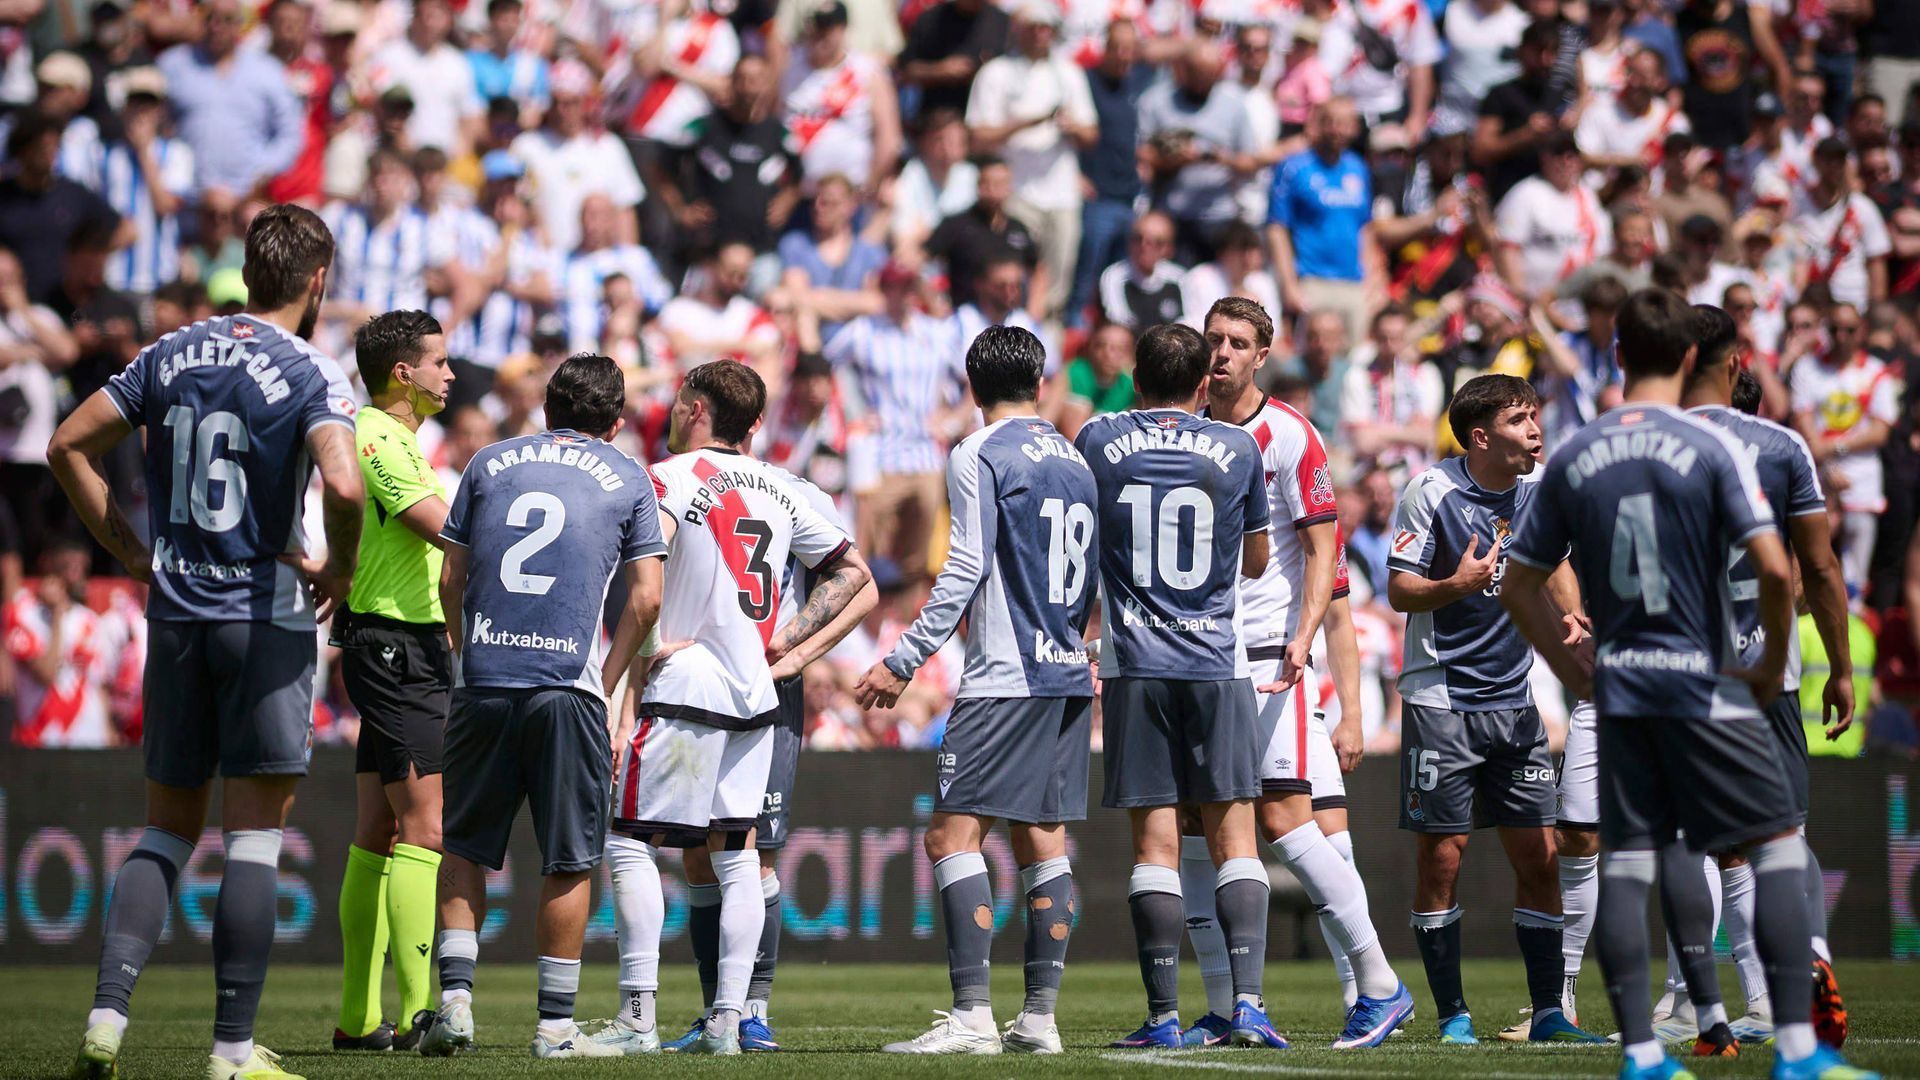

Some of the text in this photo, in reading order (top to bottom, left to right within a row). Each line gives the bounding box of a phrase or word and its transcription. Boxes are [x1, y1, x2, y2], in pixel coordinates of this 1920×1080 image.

[162, 404, 250, 533] 16
[486, 443, 625, 492] ARAMBURU
[1103, 428, 1238, 474] OYARZABAL
[684, 486, 713, 527] PEP
[499, 491, 566, 596] 2
[1038, 497, 1095, 608] 18
[1116, 484, 1214, 591] 10
[1608, 492, 1671, 617] 4
[733, 516, 775, 623] 3
[471, 612, 579, 655] Kutxabank
[1602, 647, 1711, 676] utxabank
[1408, 747, 1441, 792] 15
[120, 963, 139, 977] RS
[1154, 956, 1175, 966] RS
[1230, 946, 1250, 955] RS
[631, 1000, 642, 1021] NEO
